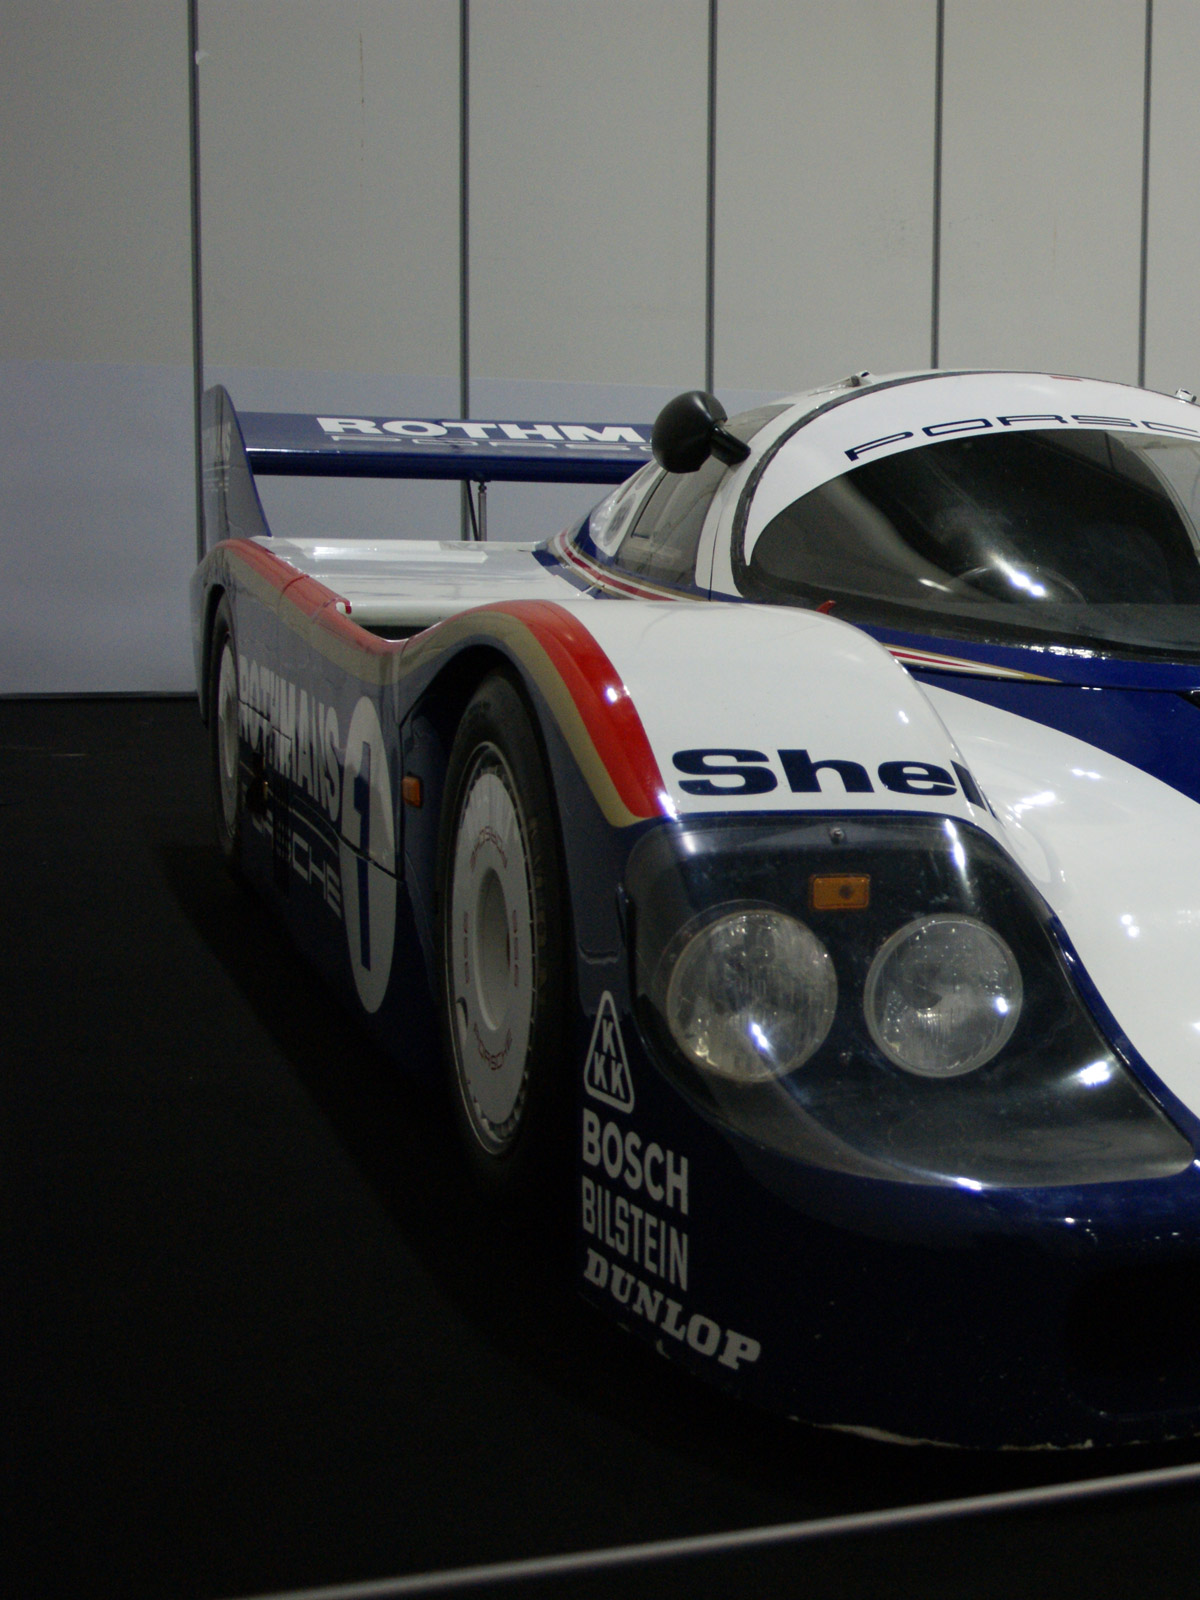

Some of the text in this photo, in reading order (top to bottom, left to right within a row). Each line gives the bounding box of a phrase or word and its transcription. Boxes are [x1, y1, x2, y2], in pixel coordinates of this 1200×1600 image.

[316, 417, 652, 443] ROTHM
[353, 742, 371, 972] 1
[582, 1107, 689, 1216] BOSCH
[582, 1175, 689, 1293] BILSTEIN
[583, 1247, 761, 1371] DUNLOP
